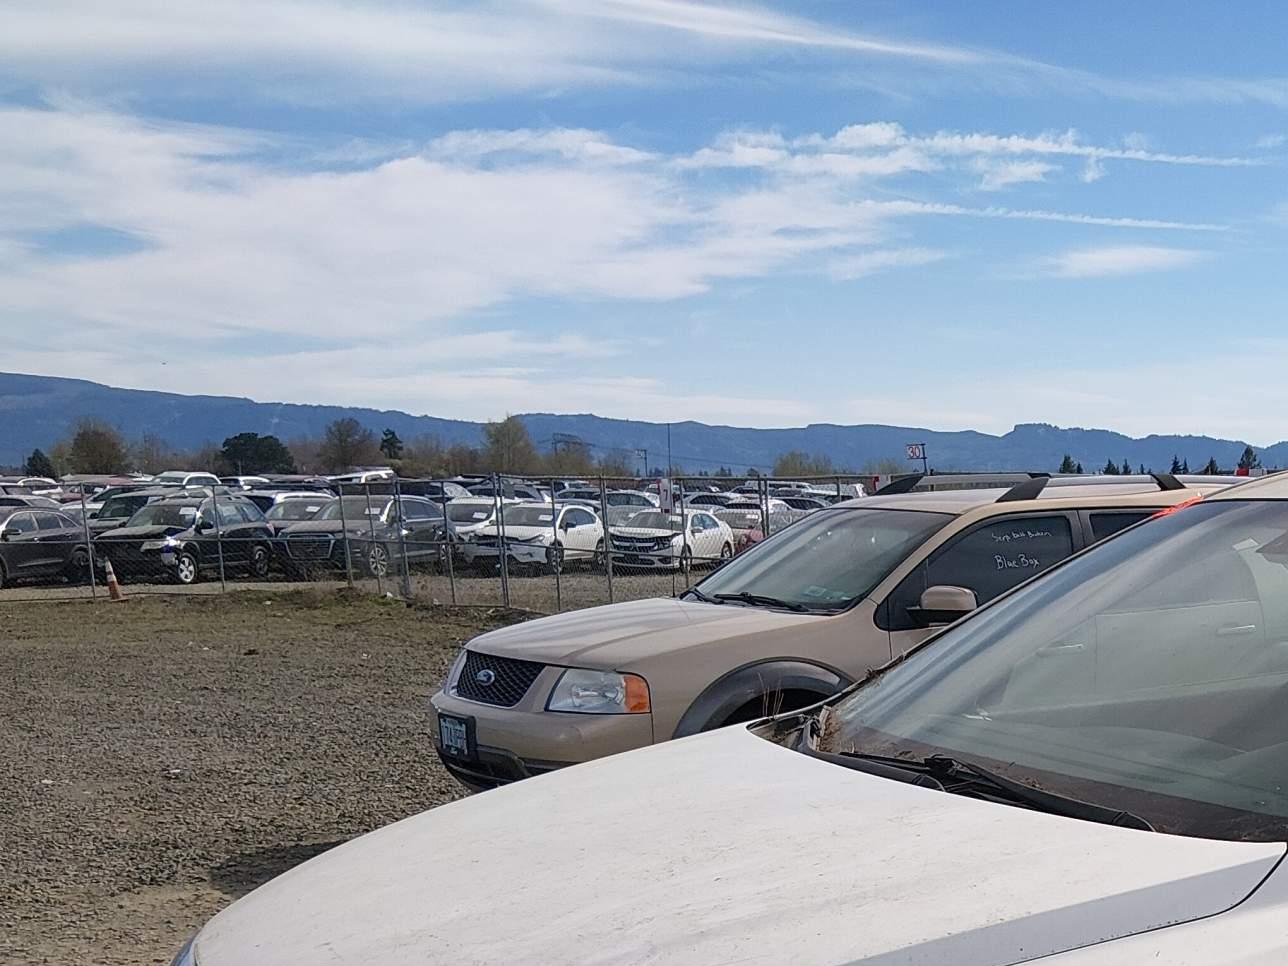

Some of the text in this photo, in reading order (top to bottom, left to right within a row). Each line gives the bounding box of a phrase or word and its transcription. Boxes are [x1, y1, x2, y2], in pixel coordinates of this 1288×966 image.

[908, 446, 921, 458] 30
[994, 553, 1040, 570] Blue Box
